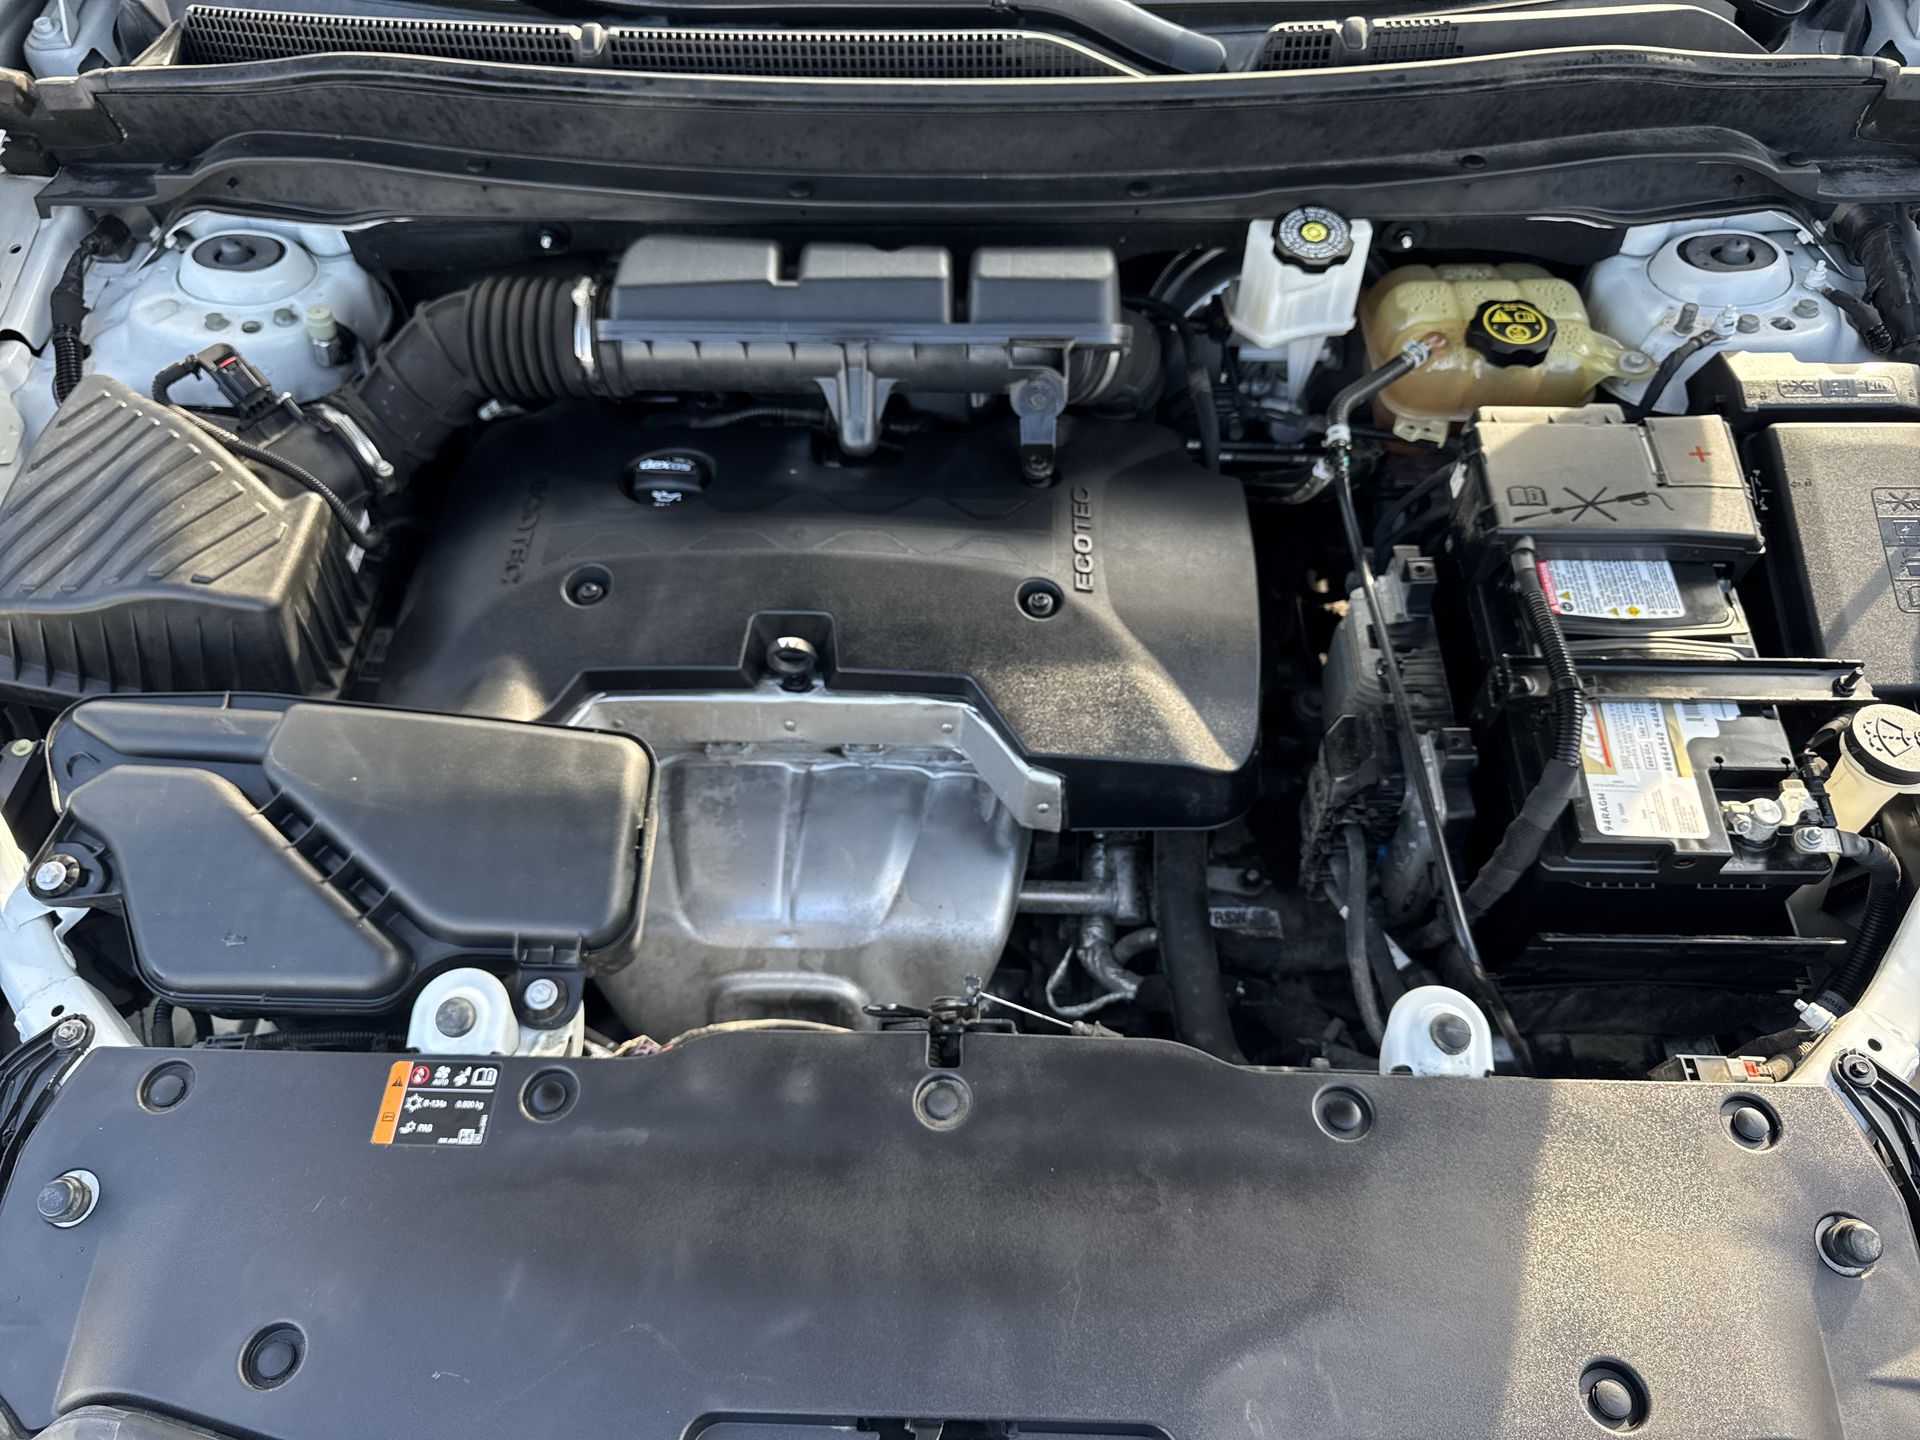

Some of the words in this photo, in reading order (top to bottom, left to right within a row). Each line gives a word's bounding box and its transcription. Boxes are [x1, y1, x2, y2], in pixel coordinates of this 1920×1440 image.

[639, 459, 692, 472] dexos
[1071, 485, 1094, 594] ECOTEC
[1596, 792, 1614, 832] 94RAGM
